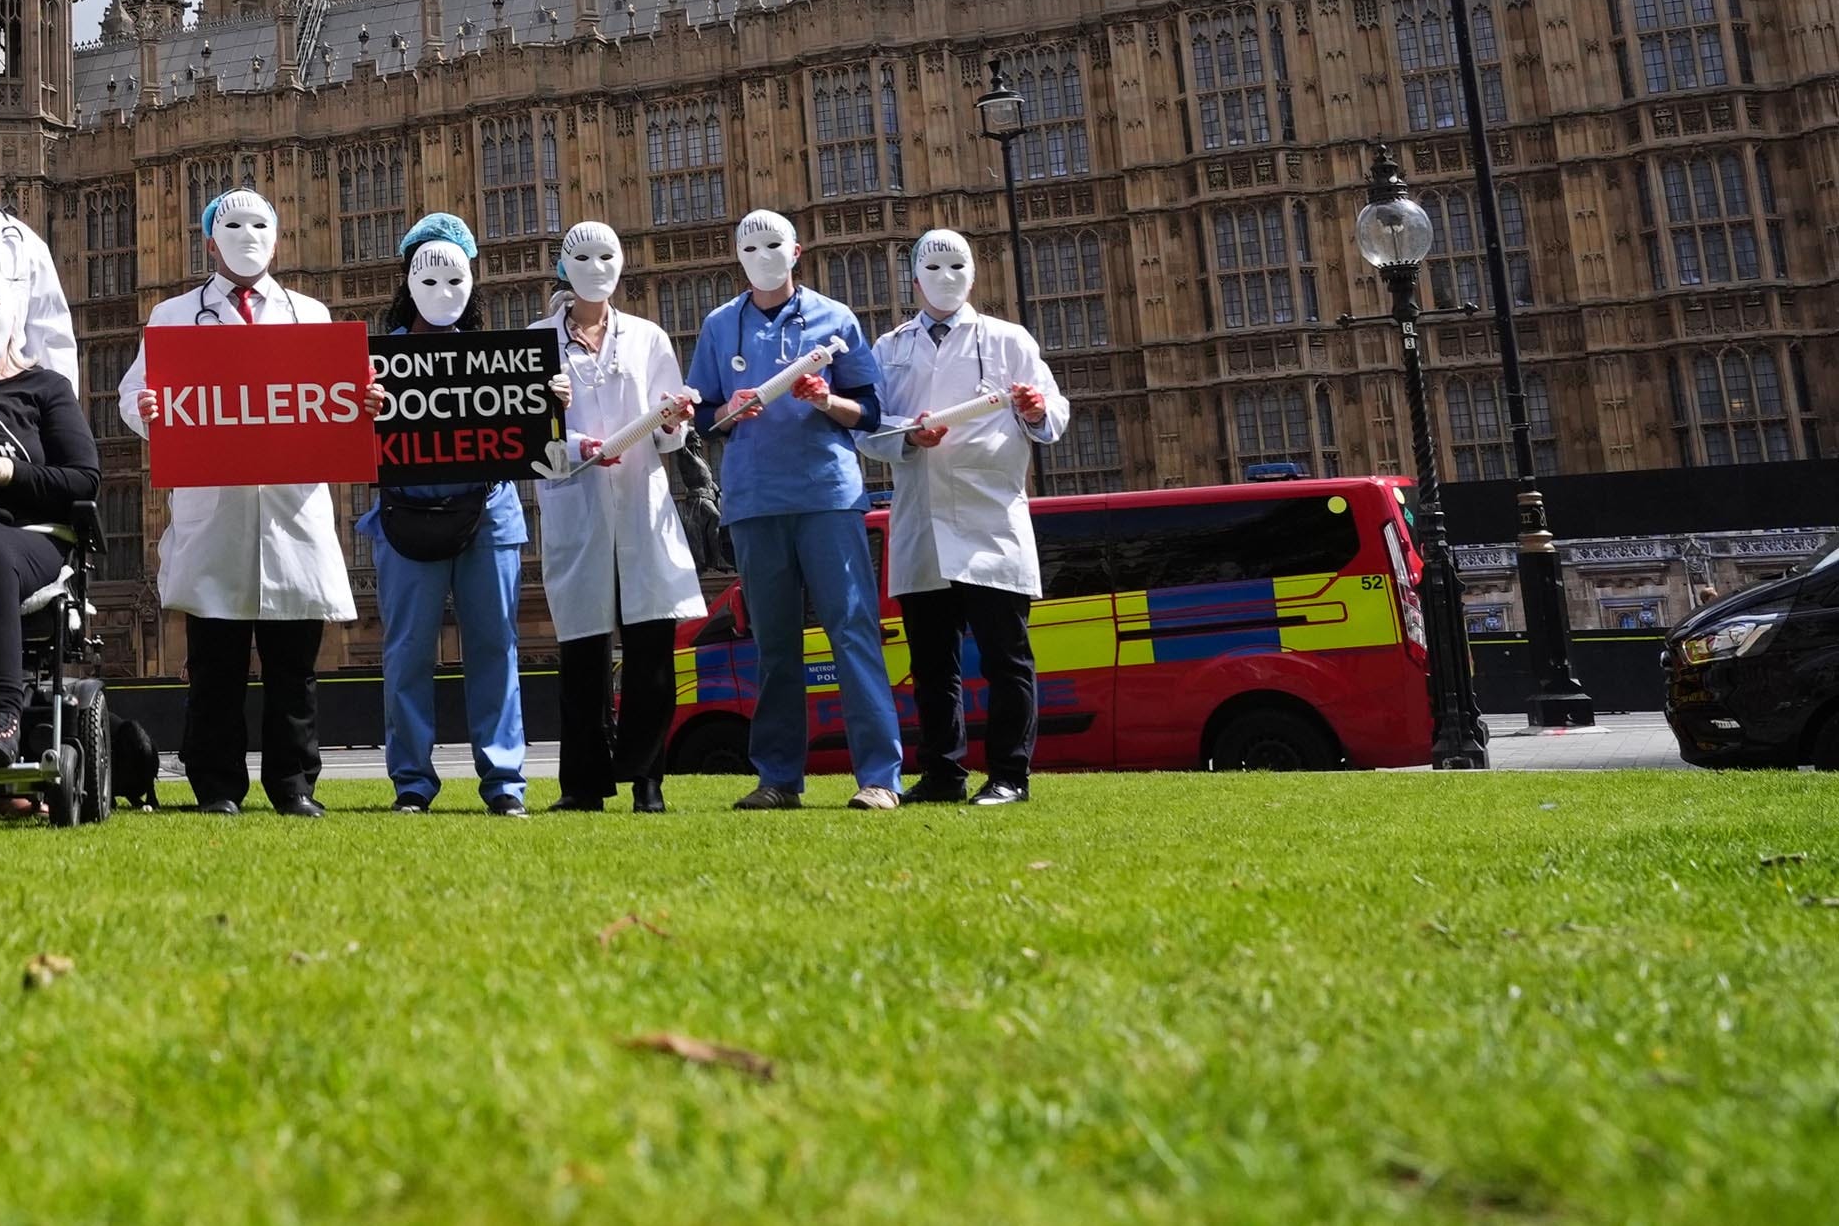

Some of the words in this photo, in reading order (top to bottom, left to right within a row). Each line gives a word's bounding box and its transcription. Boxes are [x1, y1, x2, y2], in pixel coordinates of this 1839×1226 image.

[369, 351, 458, 380] DON'T
[466, 348, 544, 375] MAKE
[163, 381, 359, 427] KILLERS
[374, 383, 548, 422] DOCTORS
[378, 427, 526, 467] KILLERS
[1361, 575, 1384, 591] 52
